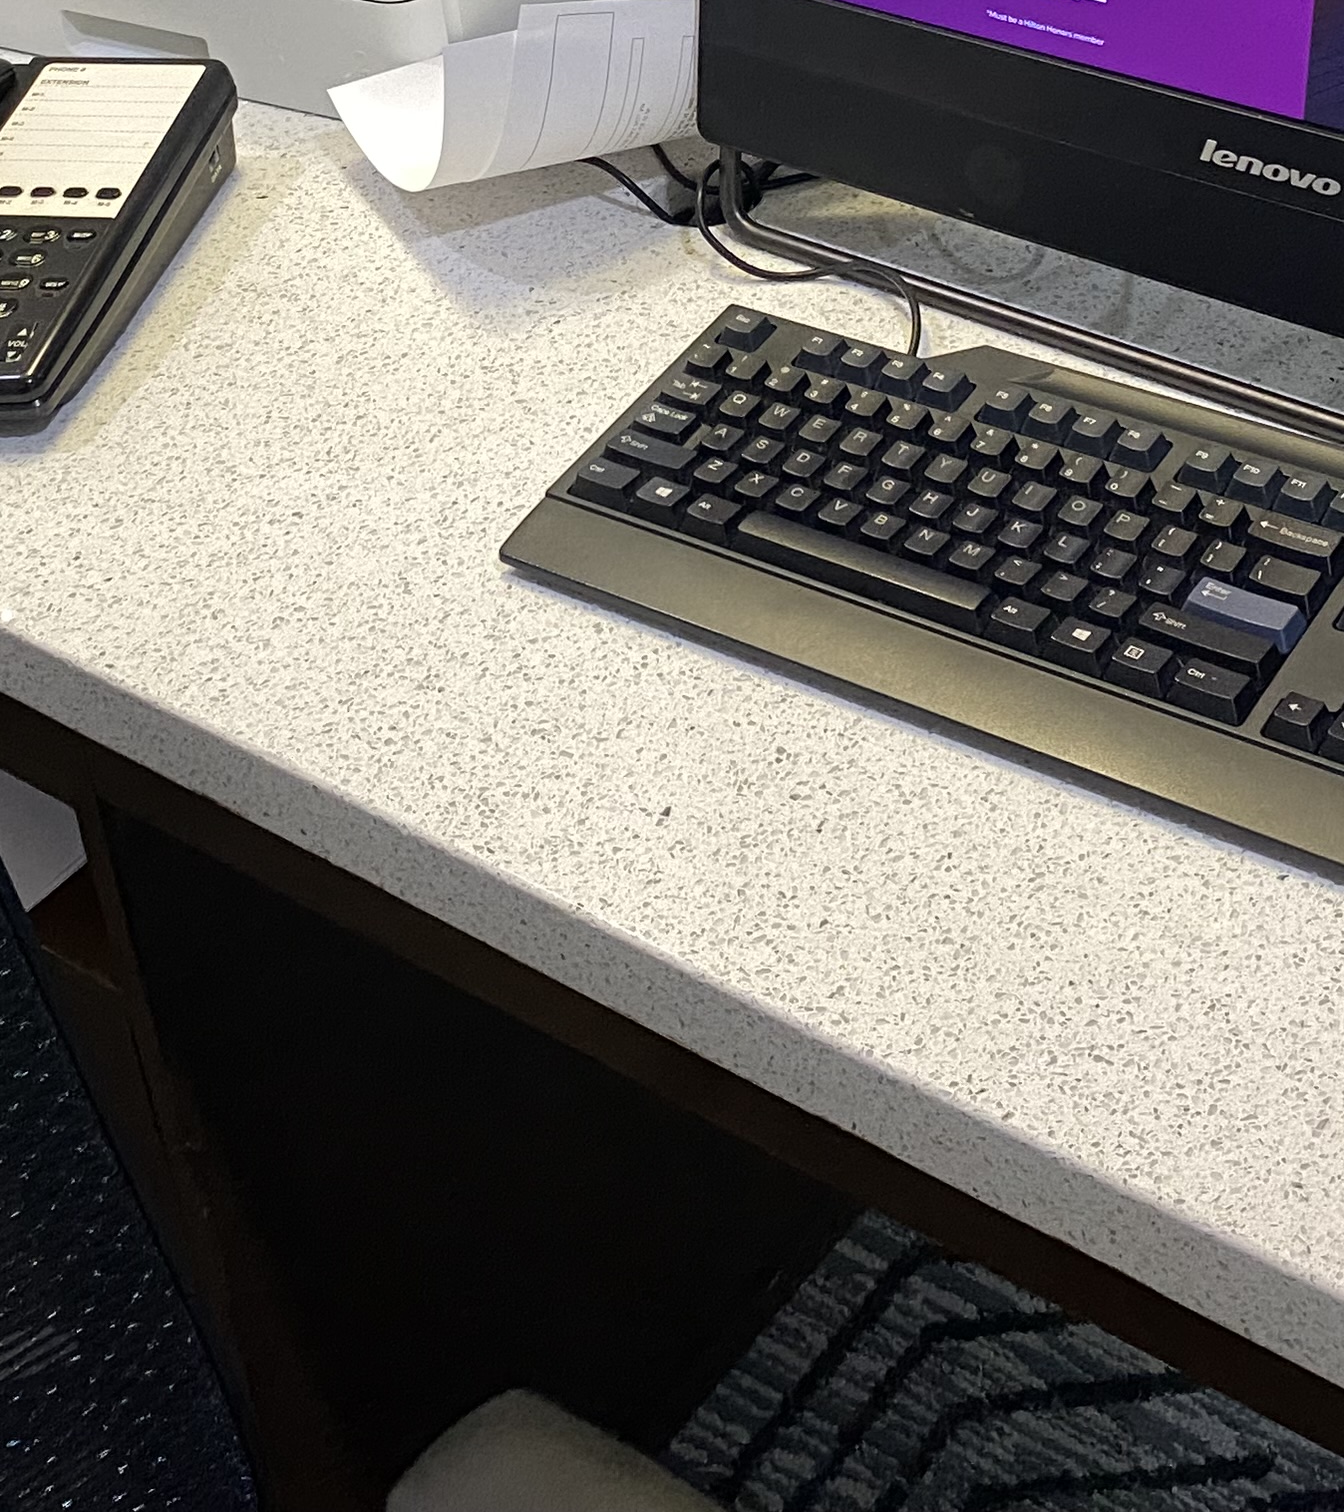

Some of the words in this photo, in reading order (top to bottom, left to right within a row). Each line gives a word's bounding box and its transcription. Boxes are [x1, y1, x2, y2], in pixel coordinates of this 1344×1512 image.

[1199, 139, 1342, 196] lenovo
[8, 340, 26, 348] VOL
[811, 336, 824, 345] F1
[733, 394, 747, 405] Q
[773, 406, 790, 418] W
[812, 419, 826, 429] E
[1083, 417, 1097, 425] F7
[715, 427, 728, 438] A
[853, 433, 867, 442] R
[756, 440, 769, 450] S
[897, 443, 909, 455] T
[797, 453, 810, 463] D
[939, 458, 953, 468] Y
[708, 460, 723, 470] Z
[838, 465, 852, 475] F
[1243, 464, 1261, 475] F10
[749, 474, 765, 484] X
[981, 471, 996, 482] U
[881, 480, 895, 490] G
[1290, 478, 1307, 489] F11
[790, 487, 804, 497] C
[923, 492, 938, 504] H
[834, 500, 848, 511] V
[1071, 500, 1086, 511] O
[966, 507, 980, 517] J
[874, 515, 888, 525] B
[1116, 513, 1131, 523] P
[1010, 521, 1026, 533] K
[919, 529, 934, 540] N
[1278, 526, 1329, 548] Backspace
[1058, 536, 1067, 548] L
[963, 544, 981, 556] M
[1205, 582, 1232, 596] Enter
[1187, 668, 1206, 679] Ctrl
